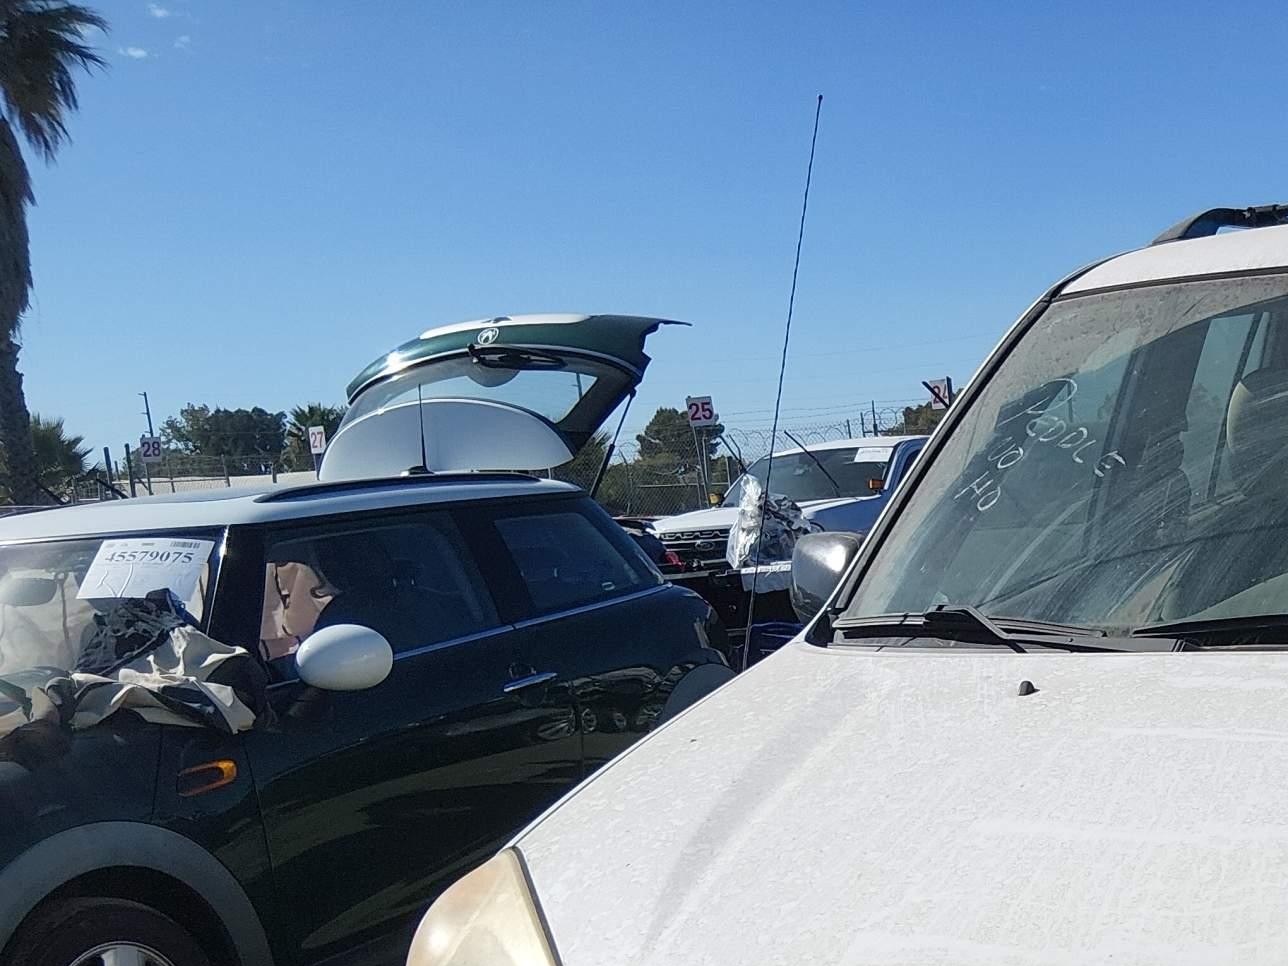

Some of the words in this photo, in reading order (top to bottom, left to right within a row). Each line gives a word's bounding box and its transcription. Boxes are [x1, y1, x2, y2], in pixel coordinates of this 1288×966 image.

[689, 402, 714, 421] 25
[310, 431, 323, 449] 27
[142, 441, 161, 457] 28
[105, 551, 195, 564] 45579075
